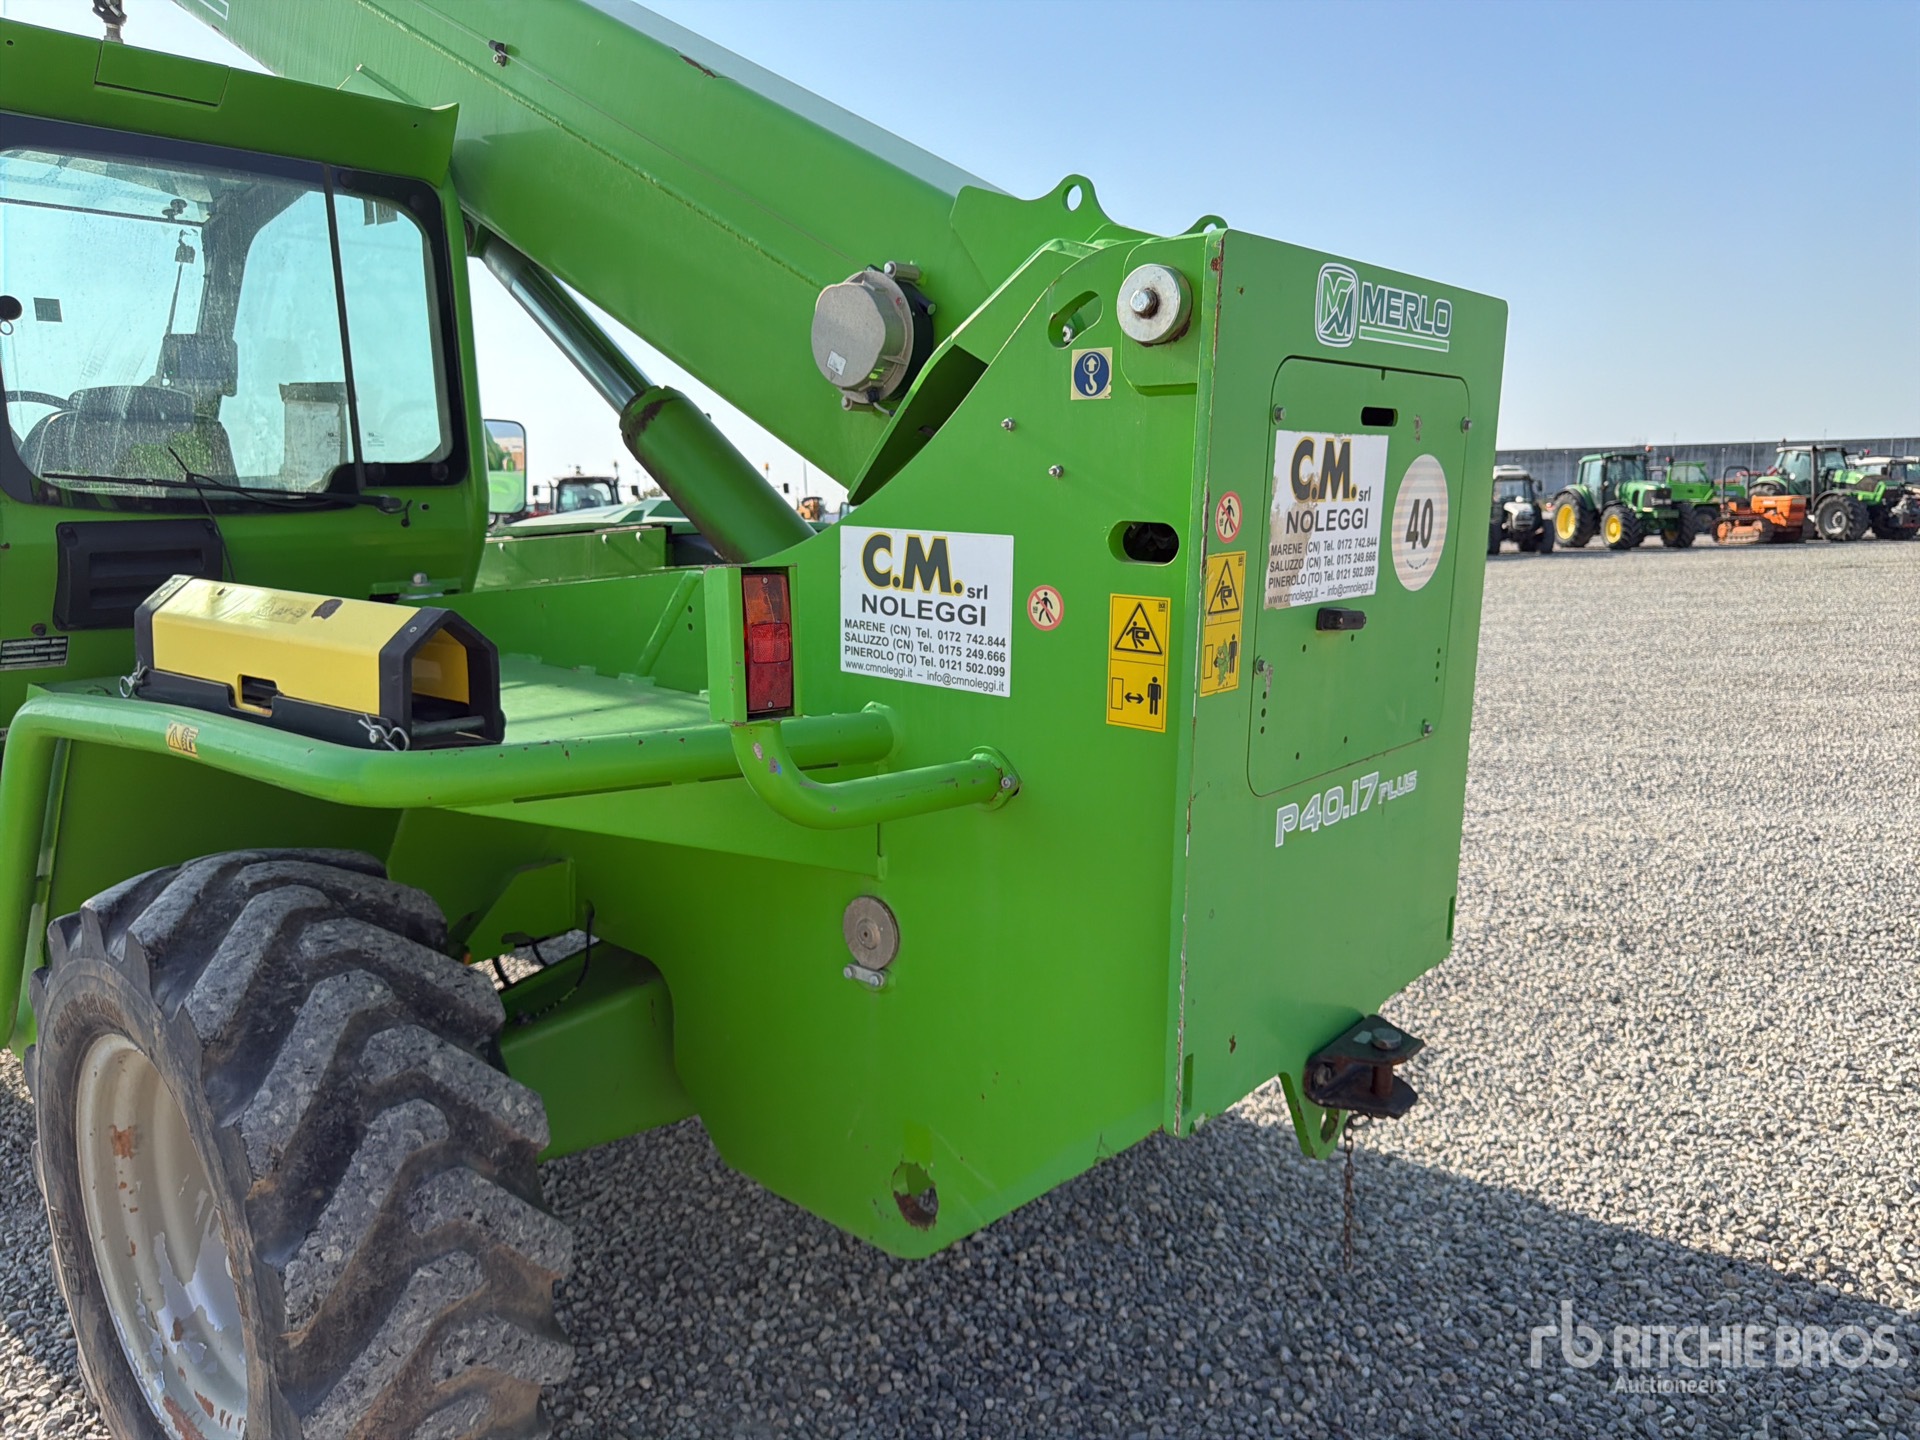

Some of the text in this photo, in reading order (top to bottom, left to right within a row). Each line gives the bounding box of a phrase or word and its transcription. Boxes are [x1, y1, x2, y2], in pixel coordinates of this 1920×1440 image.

[1360, 282, 1452, 337] MERLO
[1291, 436, 1372, 504] C.M. srl
[1286, 508, 1369, 534] NOLEGGI
[1405, 498, 1434, 550] 40
[1270, 551, 1376, 572] SALUZZO (CN) Tel. 0175 249.666
[1271, 537, 1377, 556] MARENE (CN) Tel. 0172 742.844
[862, 532, 988, 600] C.M. srl
[1268, 566, 1375, 589] PINEROLO (TO) Tel. 0121 502.099
[861, 594, 986, 627] NOLEGGI
[844, 618, 1006, 648] MARENE (CN) Tel. 0172 742.844
[844, 632, 1006, 662] SALUZZO (CN) Tel. 0175 249.666
[844, 645, 1005, 677] PINEROLO (TO) Tel. 0121 502.099
[845, 660, 913, 678] www.cmnoleggi.it
[927, 670, 1004, 692] info@cmnoleggi.it
[1275, 770, 1417, 848] P40.17 PLUS
